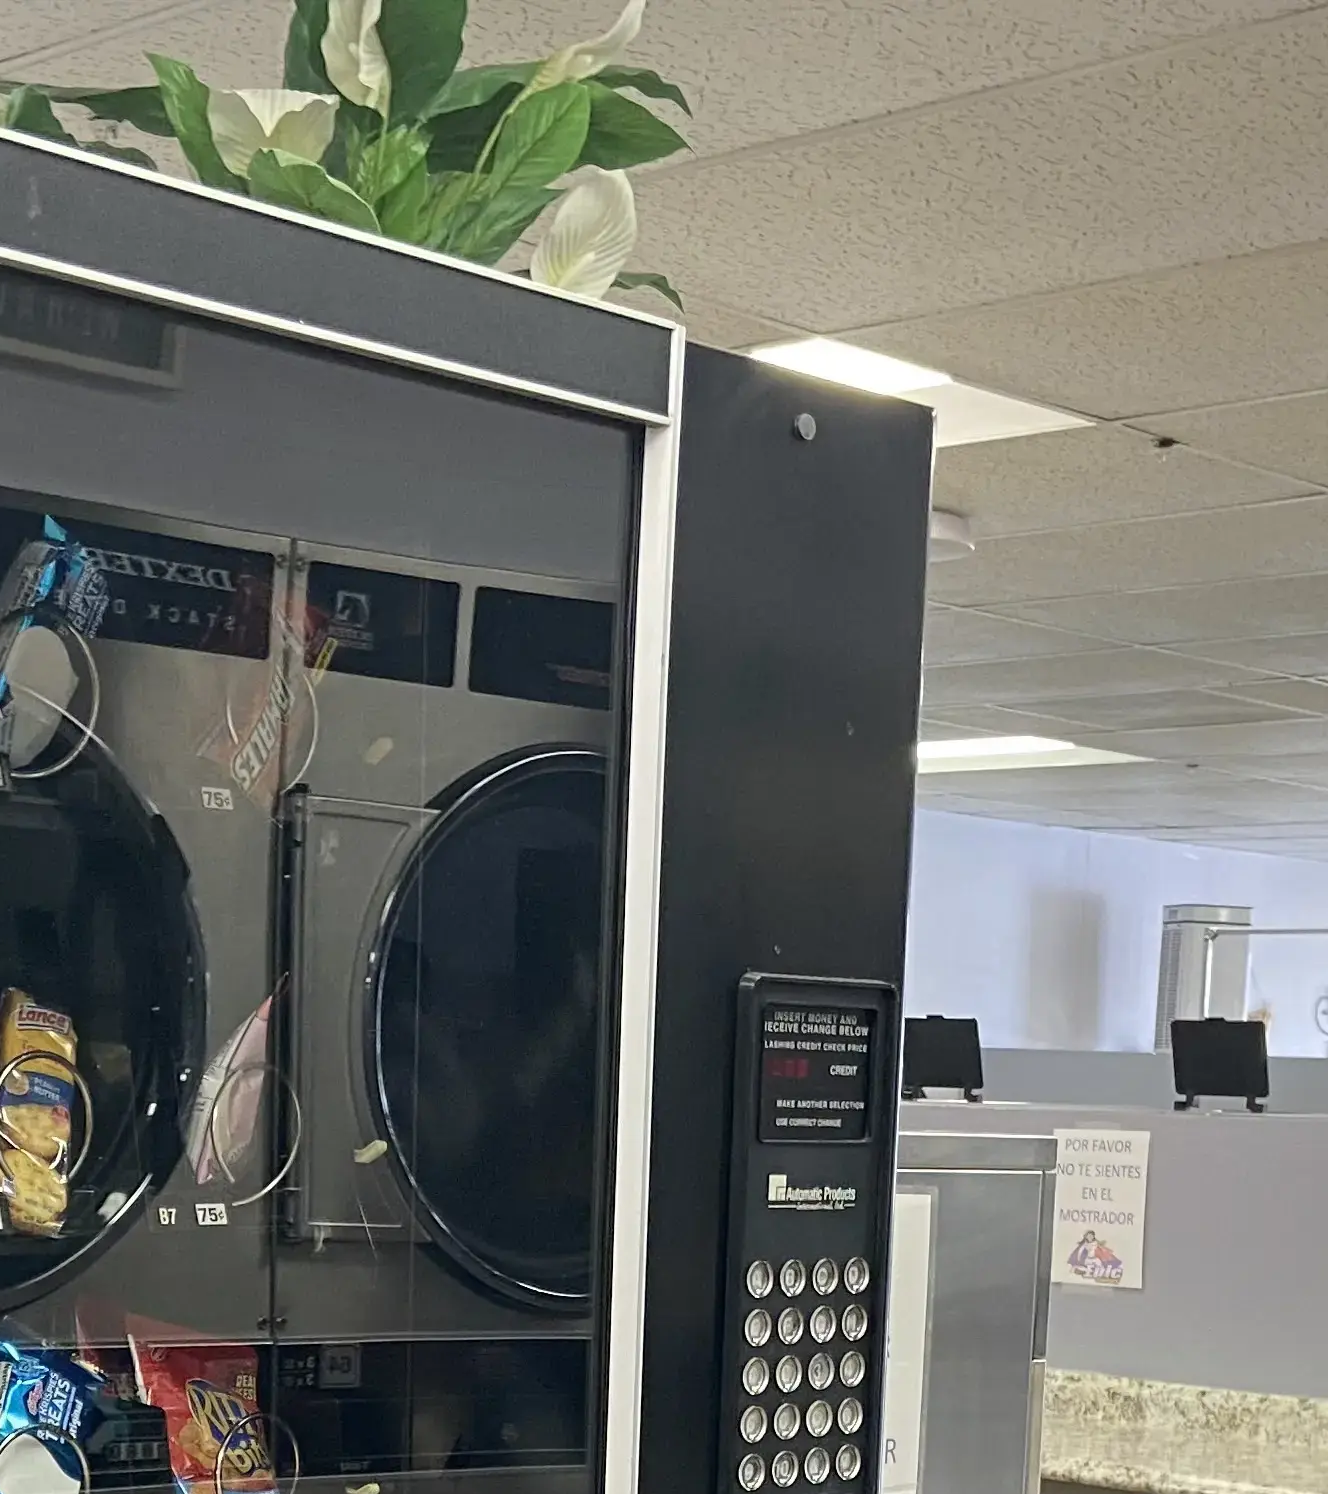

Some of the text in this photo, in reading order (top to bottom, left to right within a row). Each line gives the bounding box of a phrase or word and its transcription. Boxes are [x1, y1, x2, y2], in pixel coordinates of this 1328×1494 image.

[204, 790, 229, 807] 75¢
[18, 1009, 67, 1028] Lance
[774, 1012, 857, 1025] INSERT MONEY AND
[801, 1023, 836, 1035] CHANGE
[839, 1025, 868, 1036] BELOW
[797, 1041, 821, 1051] CREDIT
[823, 1042, 845, 1052] CHECK
[848, 1043, 867, 1053] PRICE
[830, 1065, 857, 1076] CREDIT
[777, 1100, 864, 1109] MAKE ANOTHER SELECTION
[1065, 1139, 1132, 1153] POR FAVOR
[1058, 1163, 1141, 1179] NO TE SIENTES
[786, 1187, 856, 1201] Automatic Products
[1081, 1187, 1114, 1201] EN EL
[159, 1208, 225, 1225] B7 75¢
[1059, 1208, 1135, 1226] MOSTRADOR
